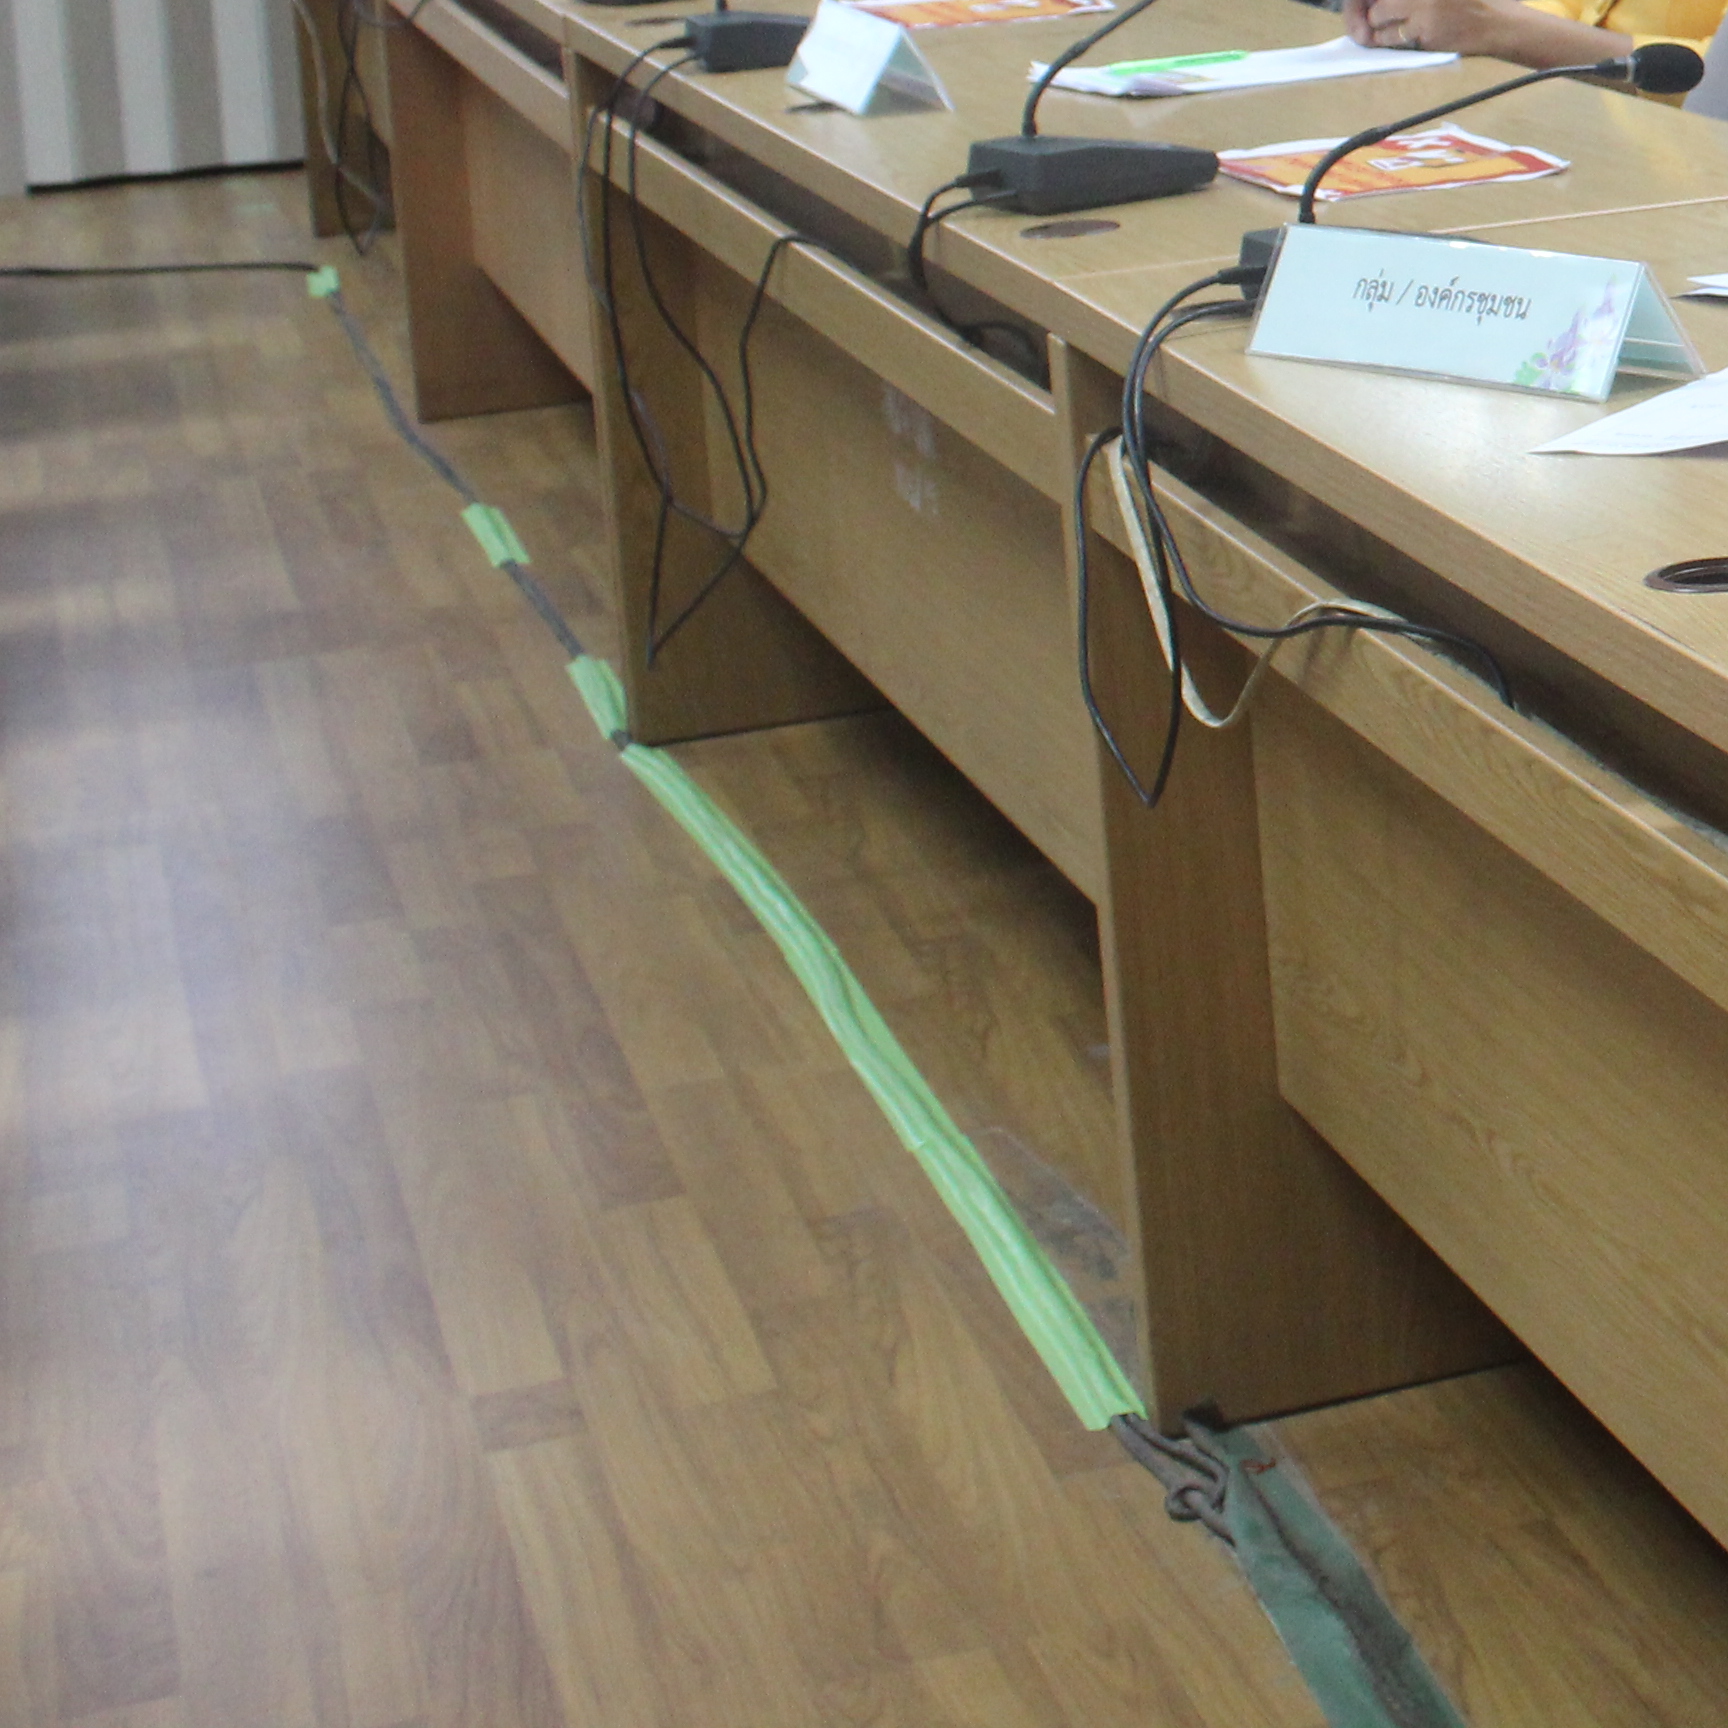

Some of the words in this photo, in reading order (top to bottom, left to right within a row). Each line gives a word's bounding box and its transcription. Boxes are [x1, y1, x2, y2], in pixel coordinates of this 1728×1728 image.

[1353, 268, 1394, 312] กลุ่ม
[1396, 279, 1414, 305] /
[1414, 276, 1532, 325] องค์กรชุมชน
